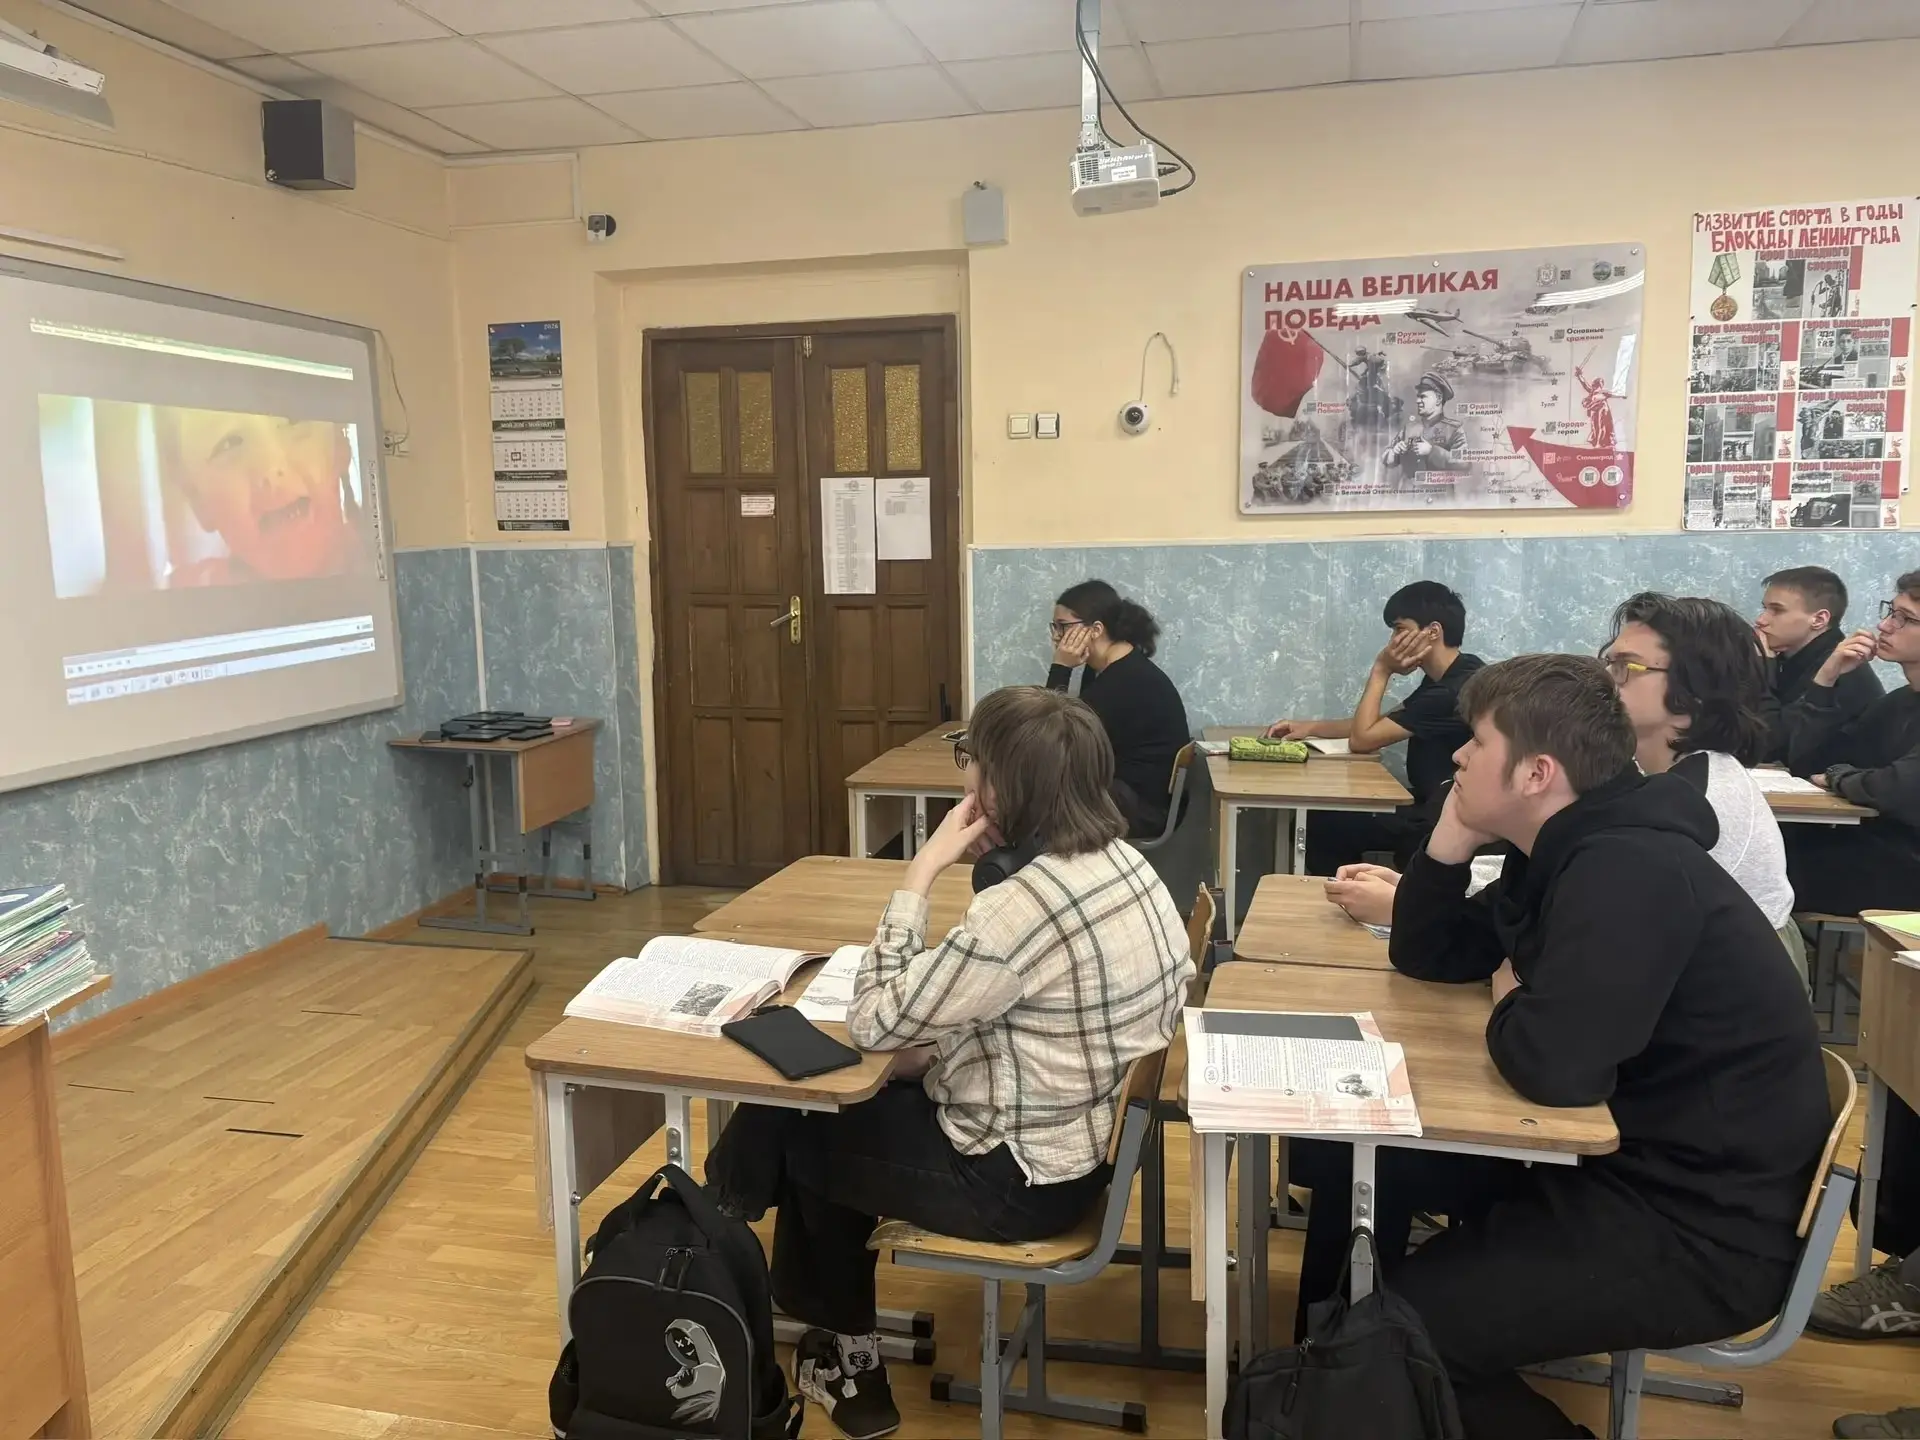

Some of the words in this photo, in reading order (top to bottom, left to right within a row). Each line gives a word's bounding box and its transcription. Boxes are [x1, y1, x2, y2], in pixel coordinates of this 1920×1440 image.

[1695, 210, 1775, 232] РАЗВИТИЕ
[1779, 208, 1832, 226] СПОРТА
[1840, 207, 1850, 223] В
[1856, 203, 1904, 221] ГОДЫ
[1711, 229, 1793, 252] БЛОКАДЫ
[1798, 225, 1901, 250] ЛЕНИНГРАДА
[1265, 278, 1354, 303] НАША
[1362, 268, 1499, 298] ВЕЛИКАЯ
[1264, 305, 1381, 331] ПОБЕДА
[1566, 327, 1605, 335] Основные
